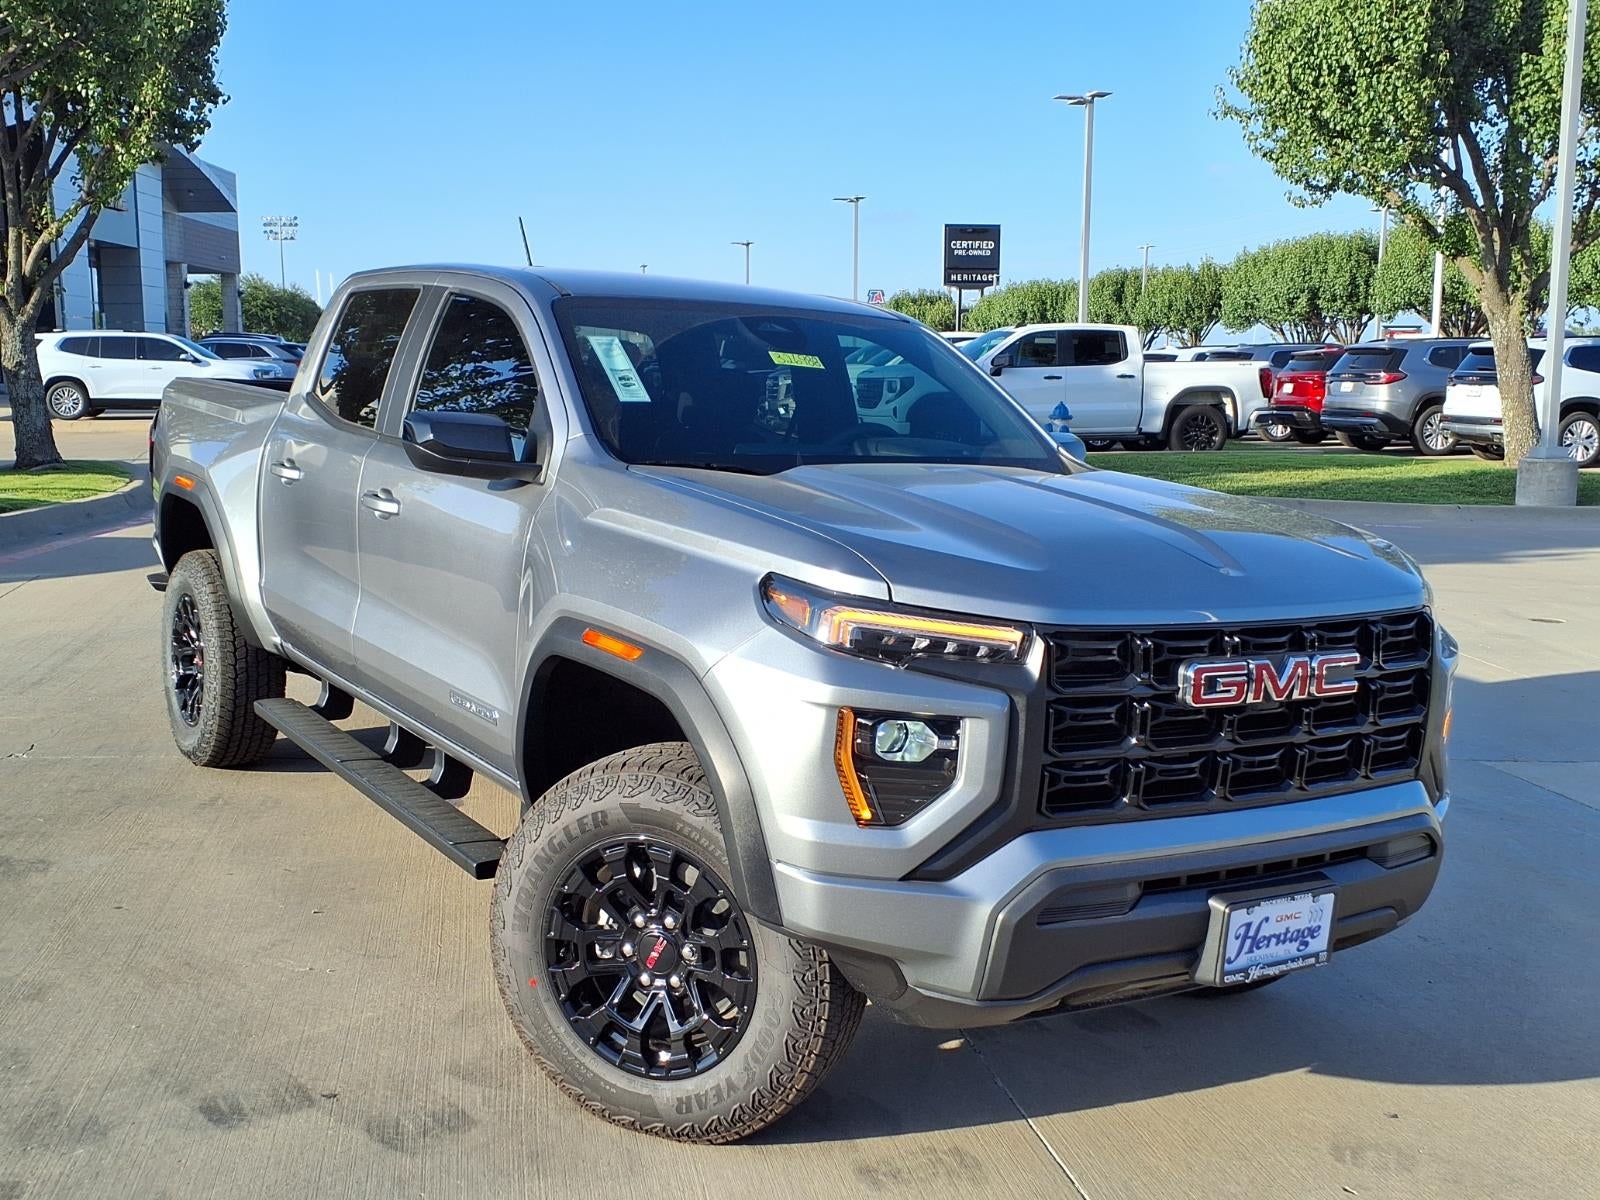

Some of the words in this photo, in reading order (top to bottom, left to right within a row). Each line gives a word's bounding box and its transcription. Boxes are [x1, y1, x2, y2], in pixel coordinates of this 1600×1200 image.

[951, 273, 994, 281] HERITAGE
[1185, 652, 1361, 708] GMC
[511, 810, 609, 933] WRANGLER
[1226, 916, 1321, 965] Heritage
[1275, 911, 1302, 923] GMC
[1224, 973, 1245, 983] GMC
[675, 985, 782, 1114] GOODYEAR
